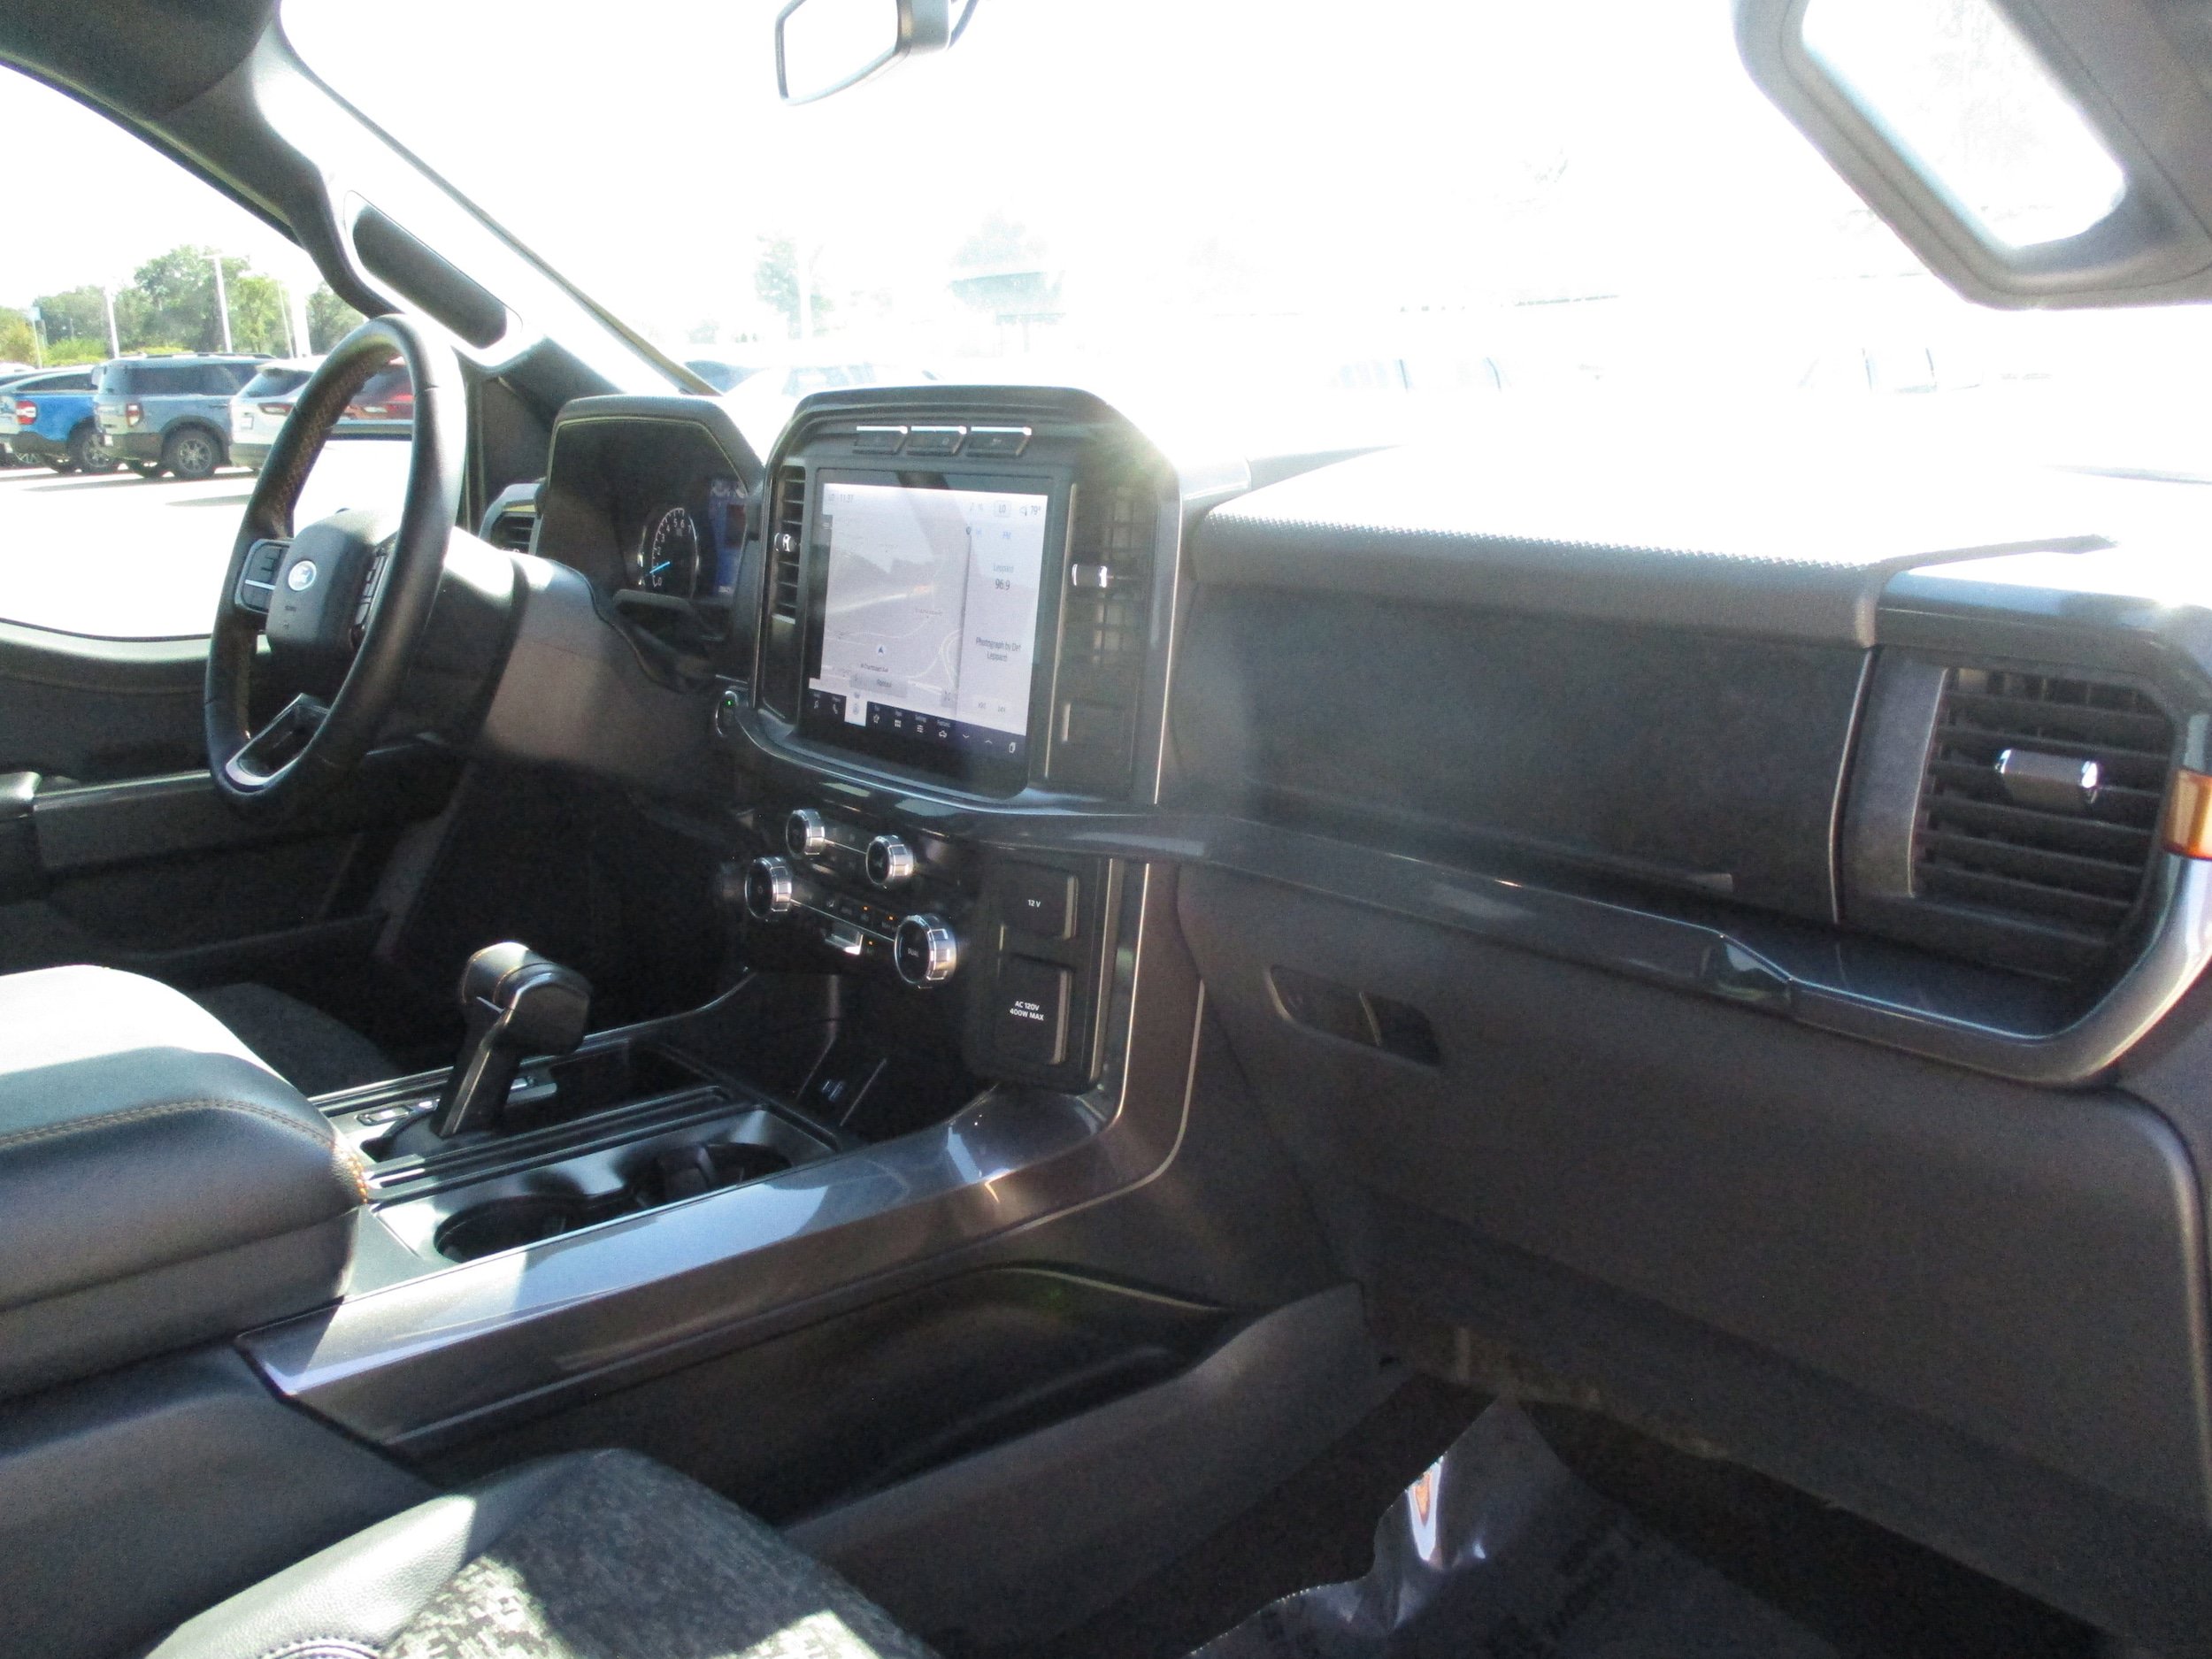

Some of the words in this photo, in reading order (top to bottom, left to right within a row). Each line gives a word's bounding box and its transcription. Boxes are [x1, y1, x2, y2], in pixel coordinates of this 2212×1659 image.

[1014, 1000, 1024, 1009] AC
[1024, 1002, 1041, 1011] 120V
[1009, 1008, 1029, 1018] 400W
[1029, 1011, 1045, 1021] MAX
